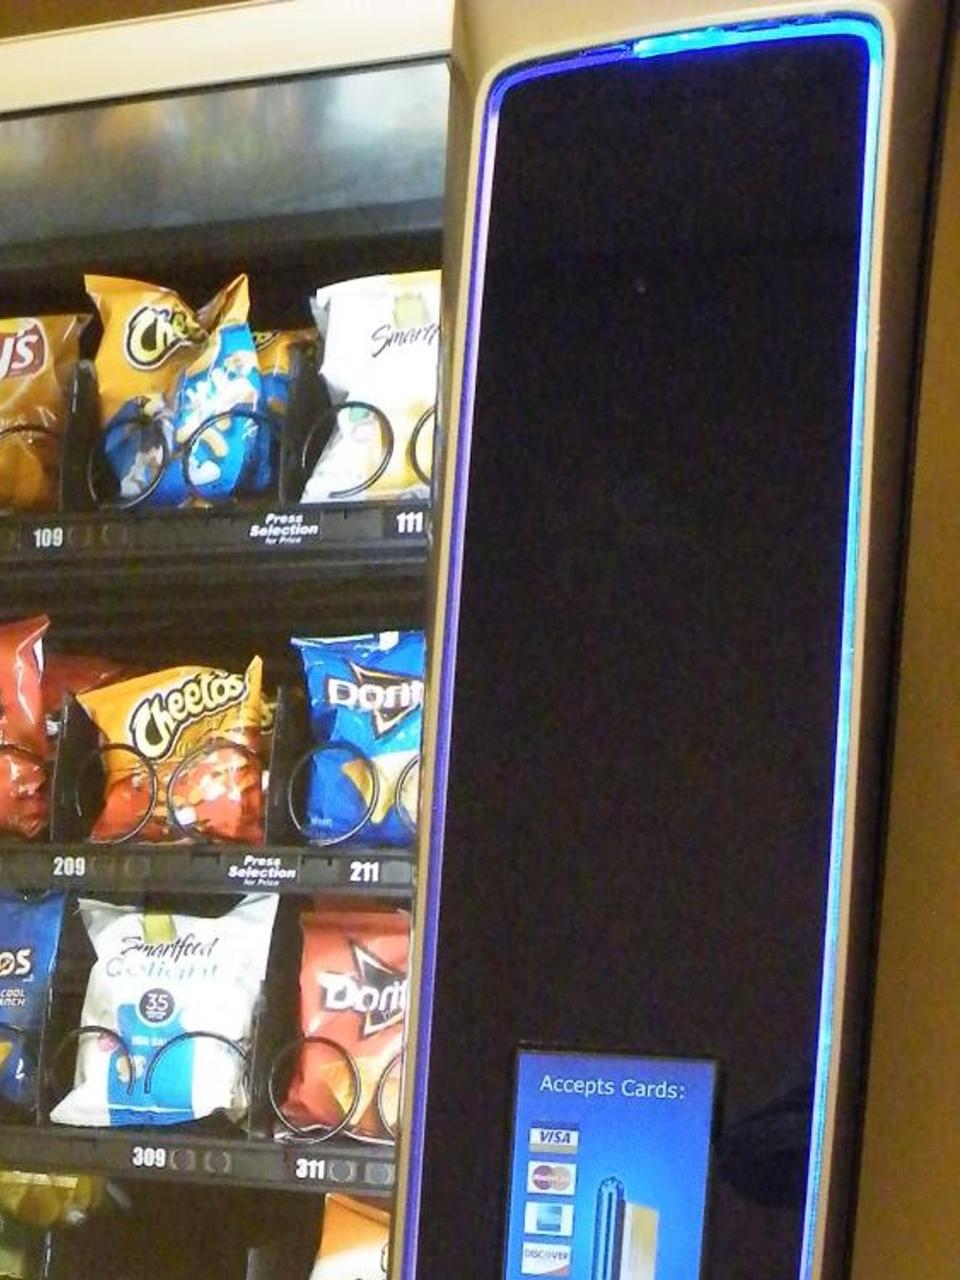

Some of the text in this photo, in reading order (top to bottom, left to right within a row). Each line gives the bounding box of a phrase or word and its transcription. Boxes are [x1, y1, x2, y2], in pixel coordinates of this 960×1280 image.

[264, 512, 305, 526] Press
[396, 511, 424, 534] 111
[33, 527, 64, 548] 109
[249, 523, 319, 538] Selection
[131, 671, 246, 759] Cheetos
[52, 856, 86, 878] 209
[243, 854, 281, 868] Press
[350, 861, 380, 882] 211
[228, 866, 296, 880] Selection
[145, 992, 169, 1011] 35
[539, 1074, 687, 1101] Accepts Cards:
[539, 1130, 572, 1145] VISA
[132, 1147, 167, 1168] 309
[295, 1158, 326, 1179] 311
